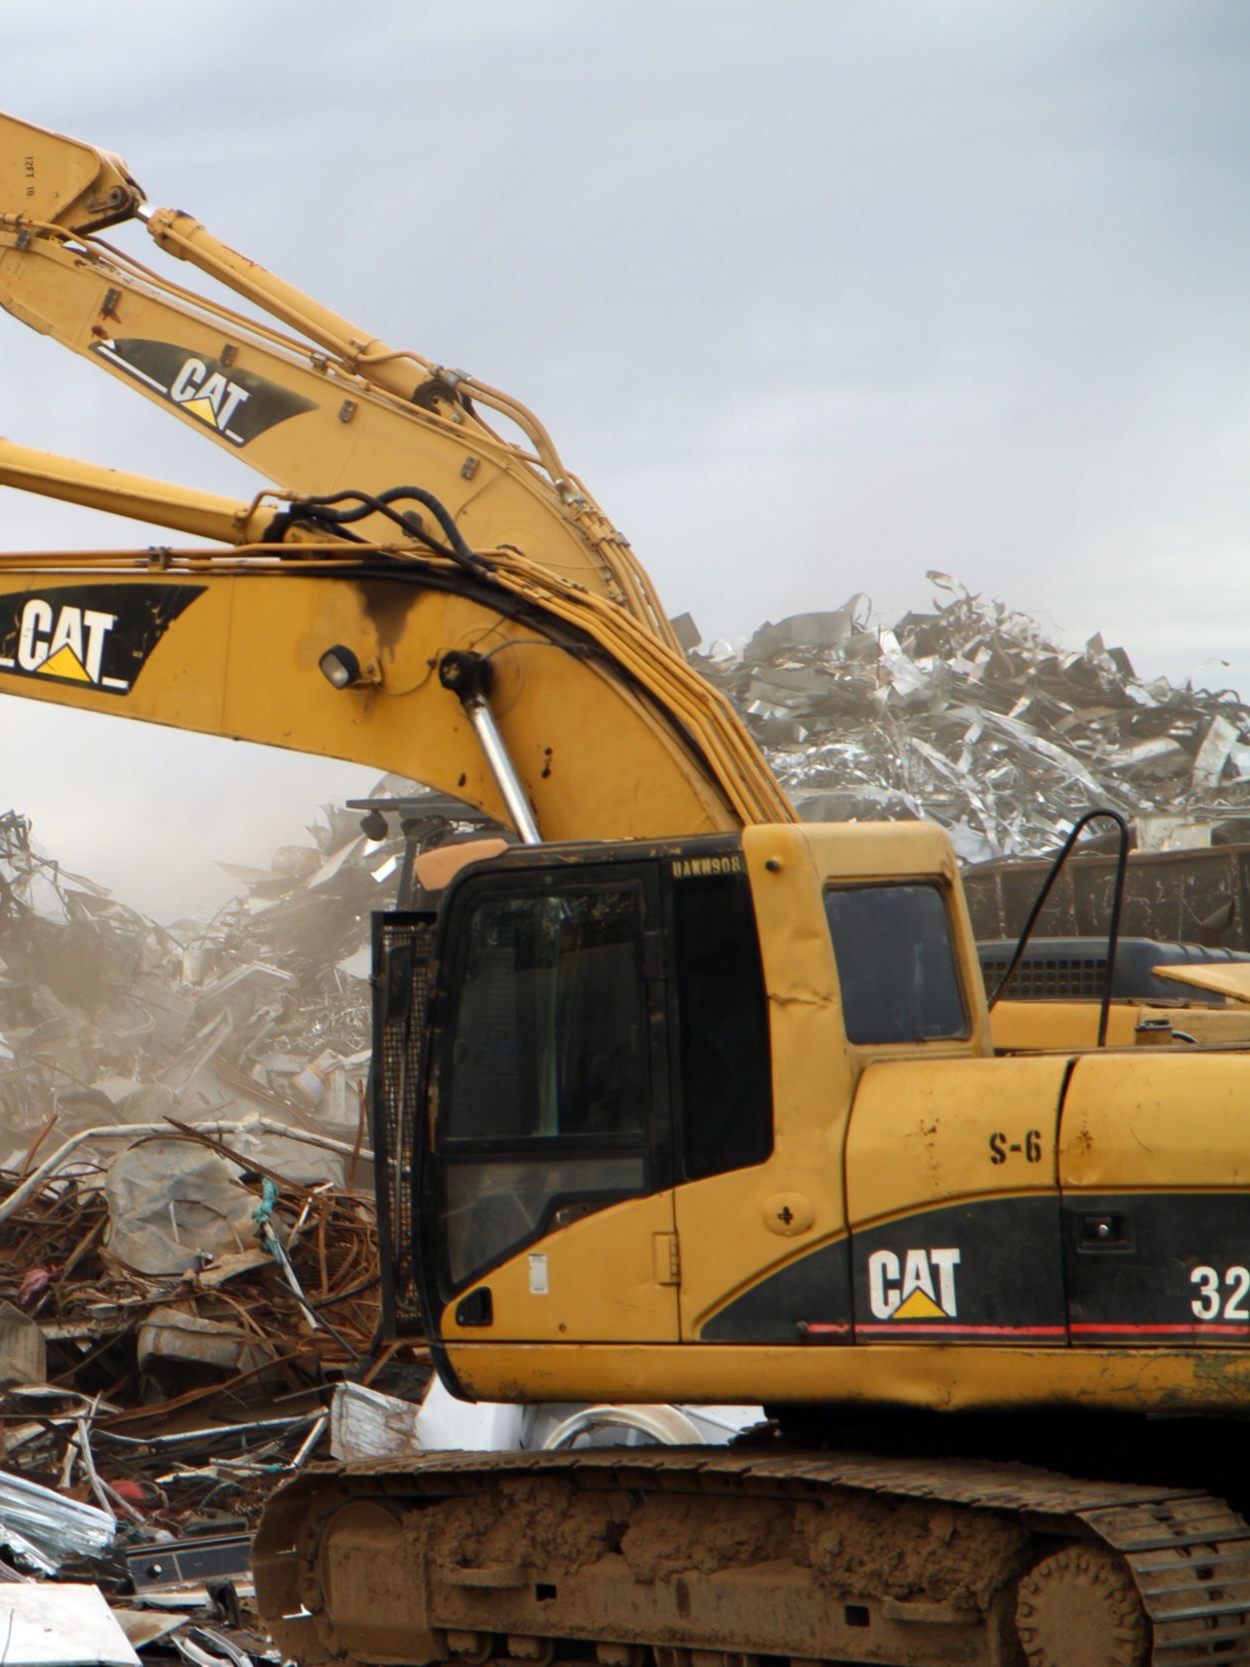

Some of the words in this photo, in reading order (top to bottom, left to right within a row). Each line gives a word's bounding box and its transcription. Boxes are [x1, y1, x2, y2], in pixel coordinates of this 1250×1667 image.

[170, 358, 250, 431] CAT
[18, 599, 114, 684] CAT
[989, 1130, 1042, 1165] S-6
[868, 1248, 961, 1320] CAT
